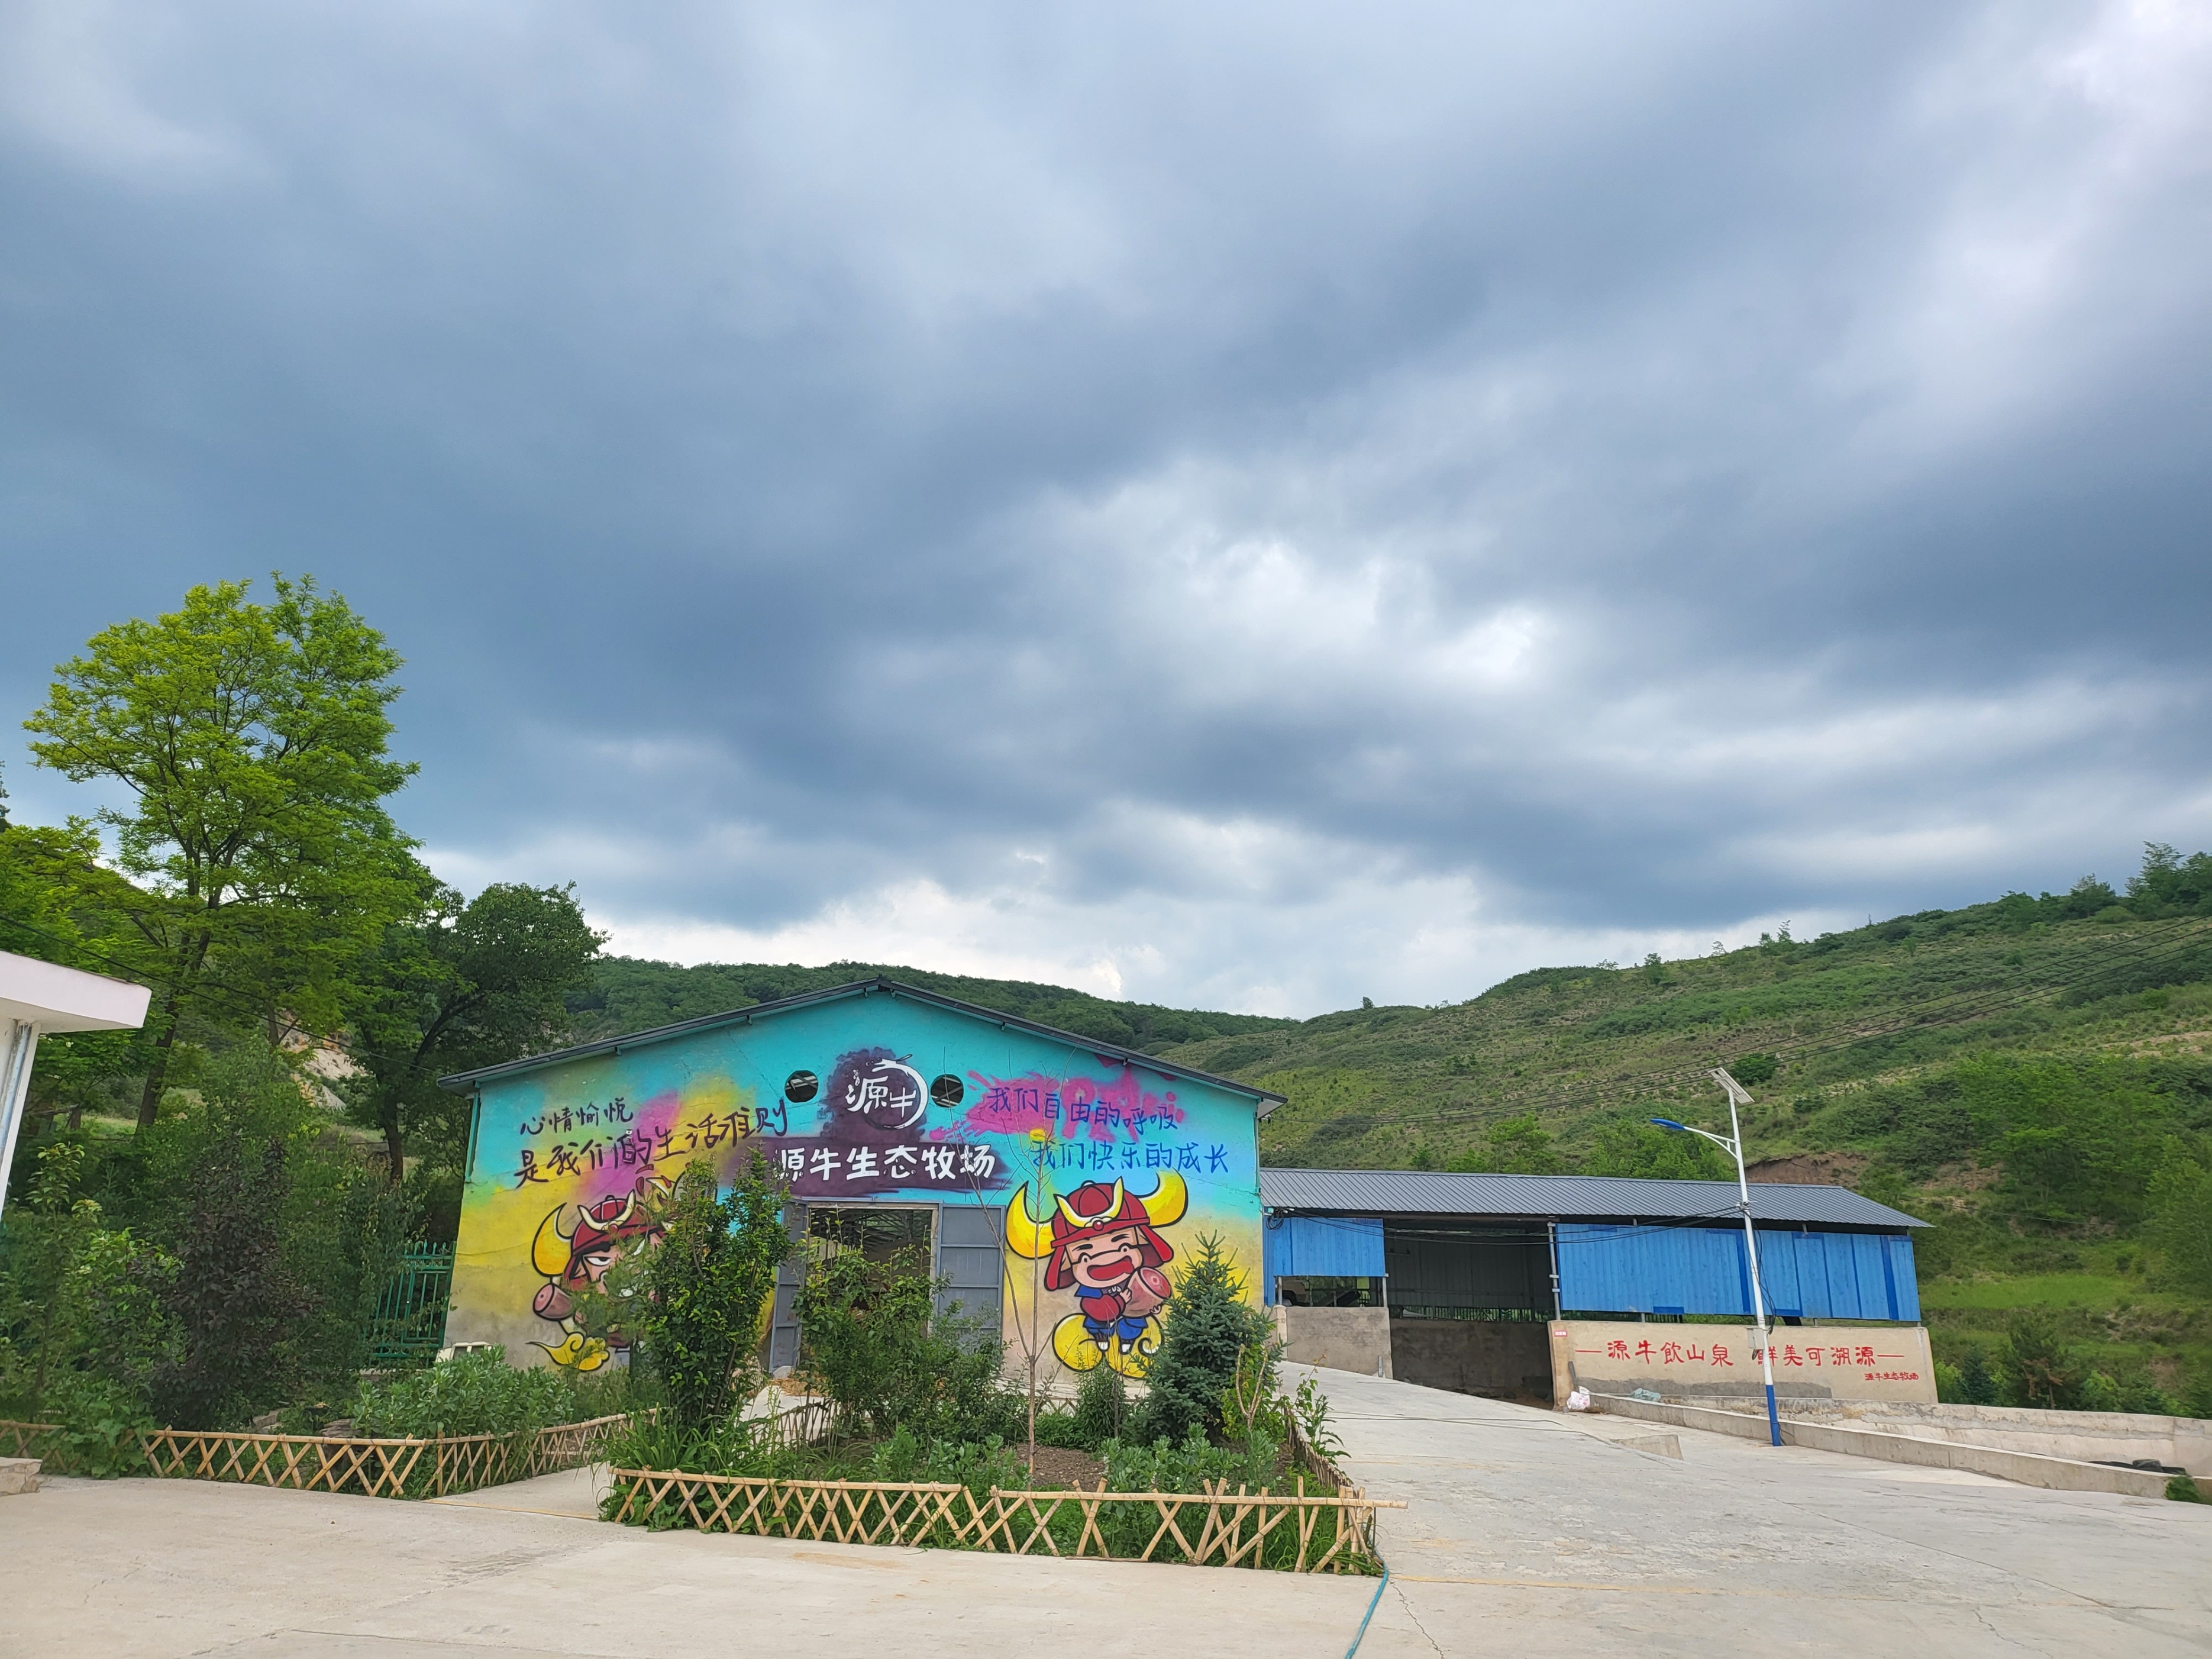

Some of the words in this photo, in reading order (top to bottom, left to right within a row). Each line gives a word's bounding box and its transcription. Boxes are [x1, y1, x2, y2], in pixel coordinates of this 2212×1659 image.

[520, 1097, 634, 1135] 心情愉悦
[987, 1087, 1178, 1135] 我们自由的呼吸
[772, 1145, 996, 1182] 源牛生态牧场
[1029, 1140, 1229, 1173] 我们快乐的成长
